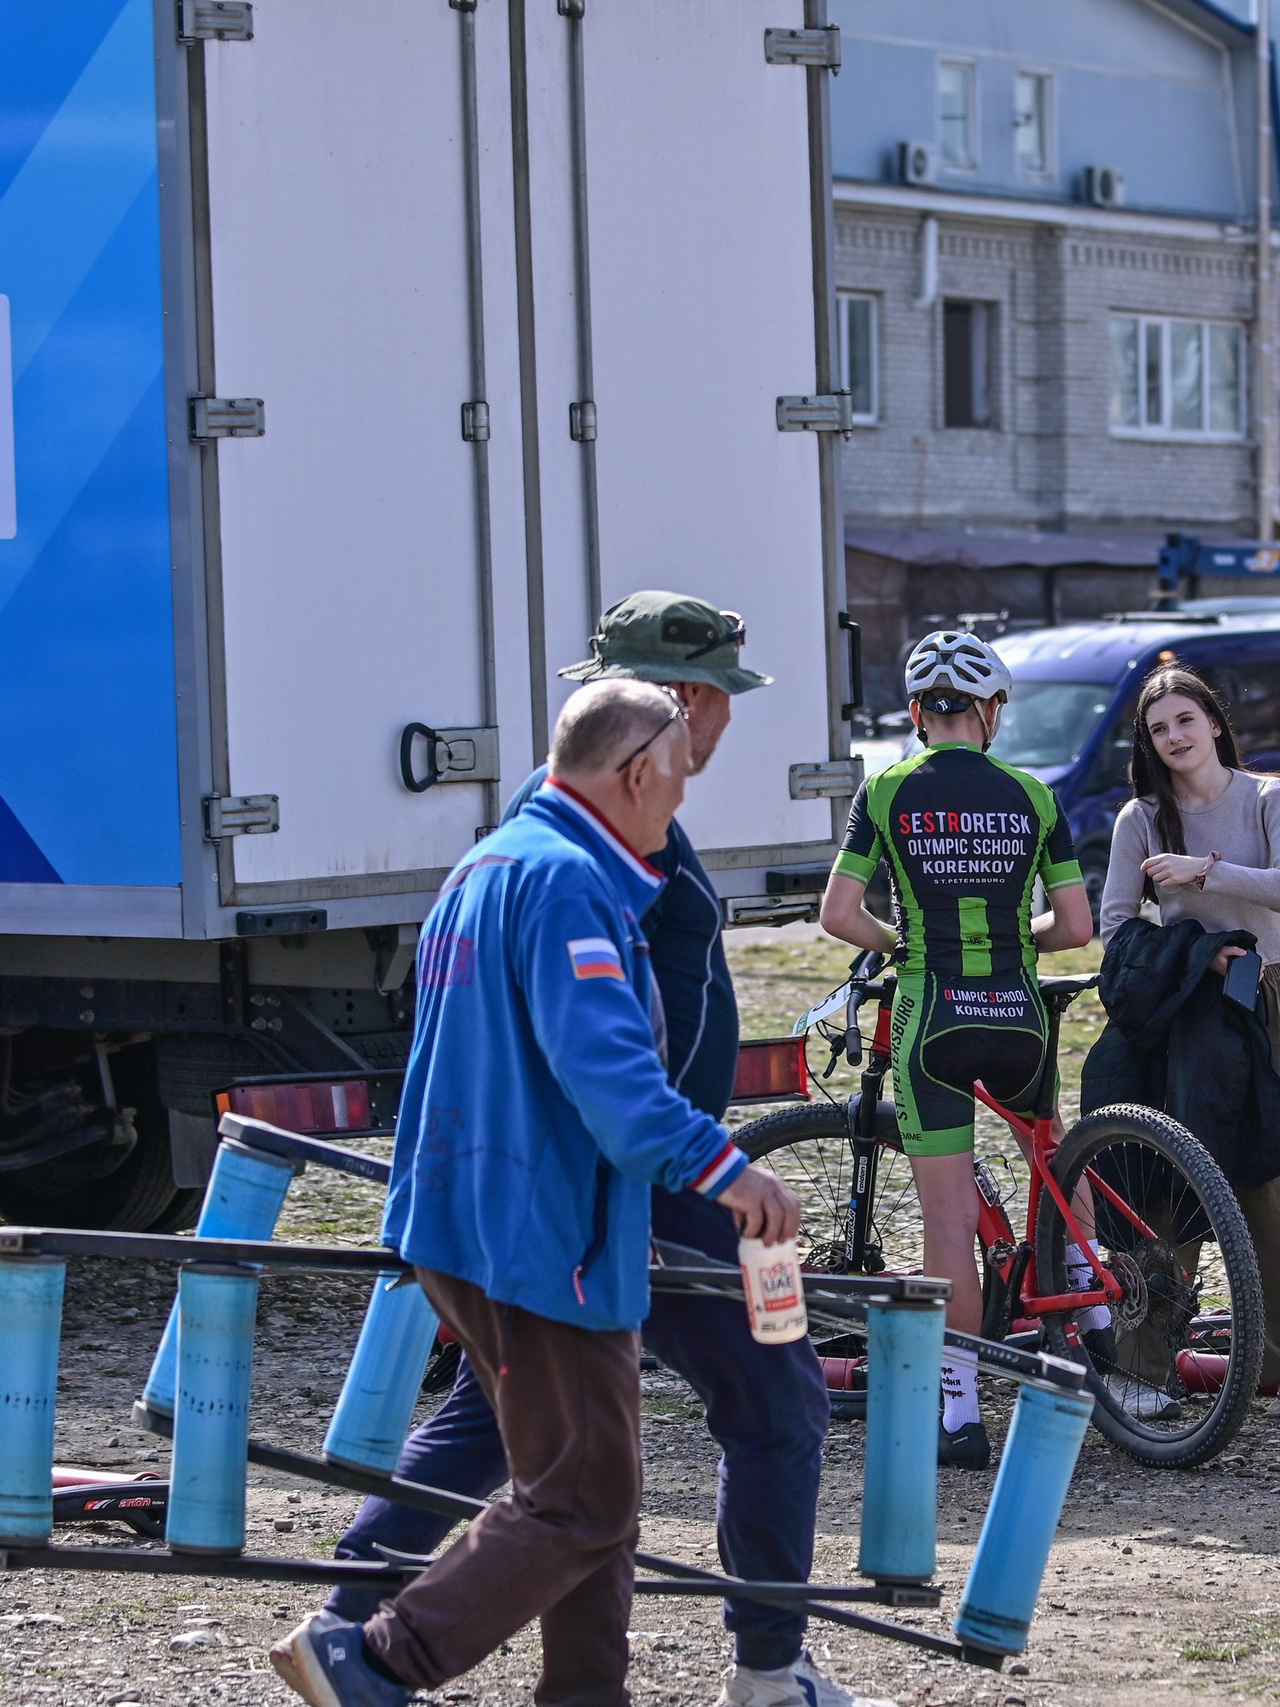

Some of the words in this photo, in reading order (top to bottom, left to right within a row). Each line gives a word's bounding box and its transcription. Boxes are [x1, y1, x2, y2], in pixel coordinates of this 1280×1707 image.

[899, 811, 1031, 835] SESTRORETSK
[908, 838, 968, 856] OLYMPIC
[973, 838, 1027, 856] SCHOOL
[922, 860, 1015, 874] KORENKOV
[944, 989, 988, 1003] OLIMPIC
[988, 989, 1029, 1004] SCHOOL
[955, 1004, 1024, 1018] KORENKOV
